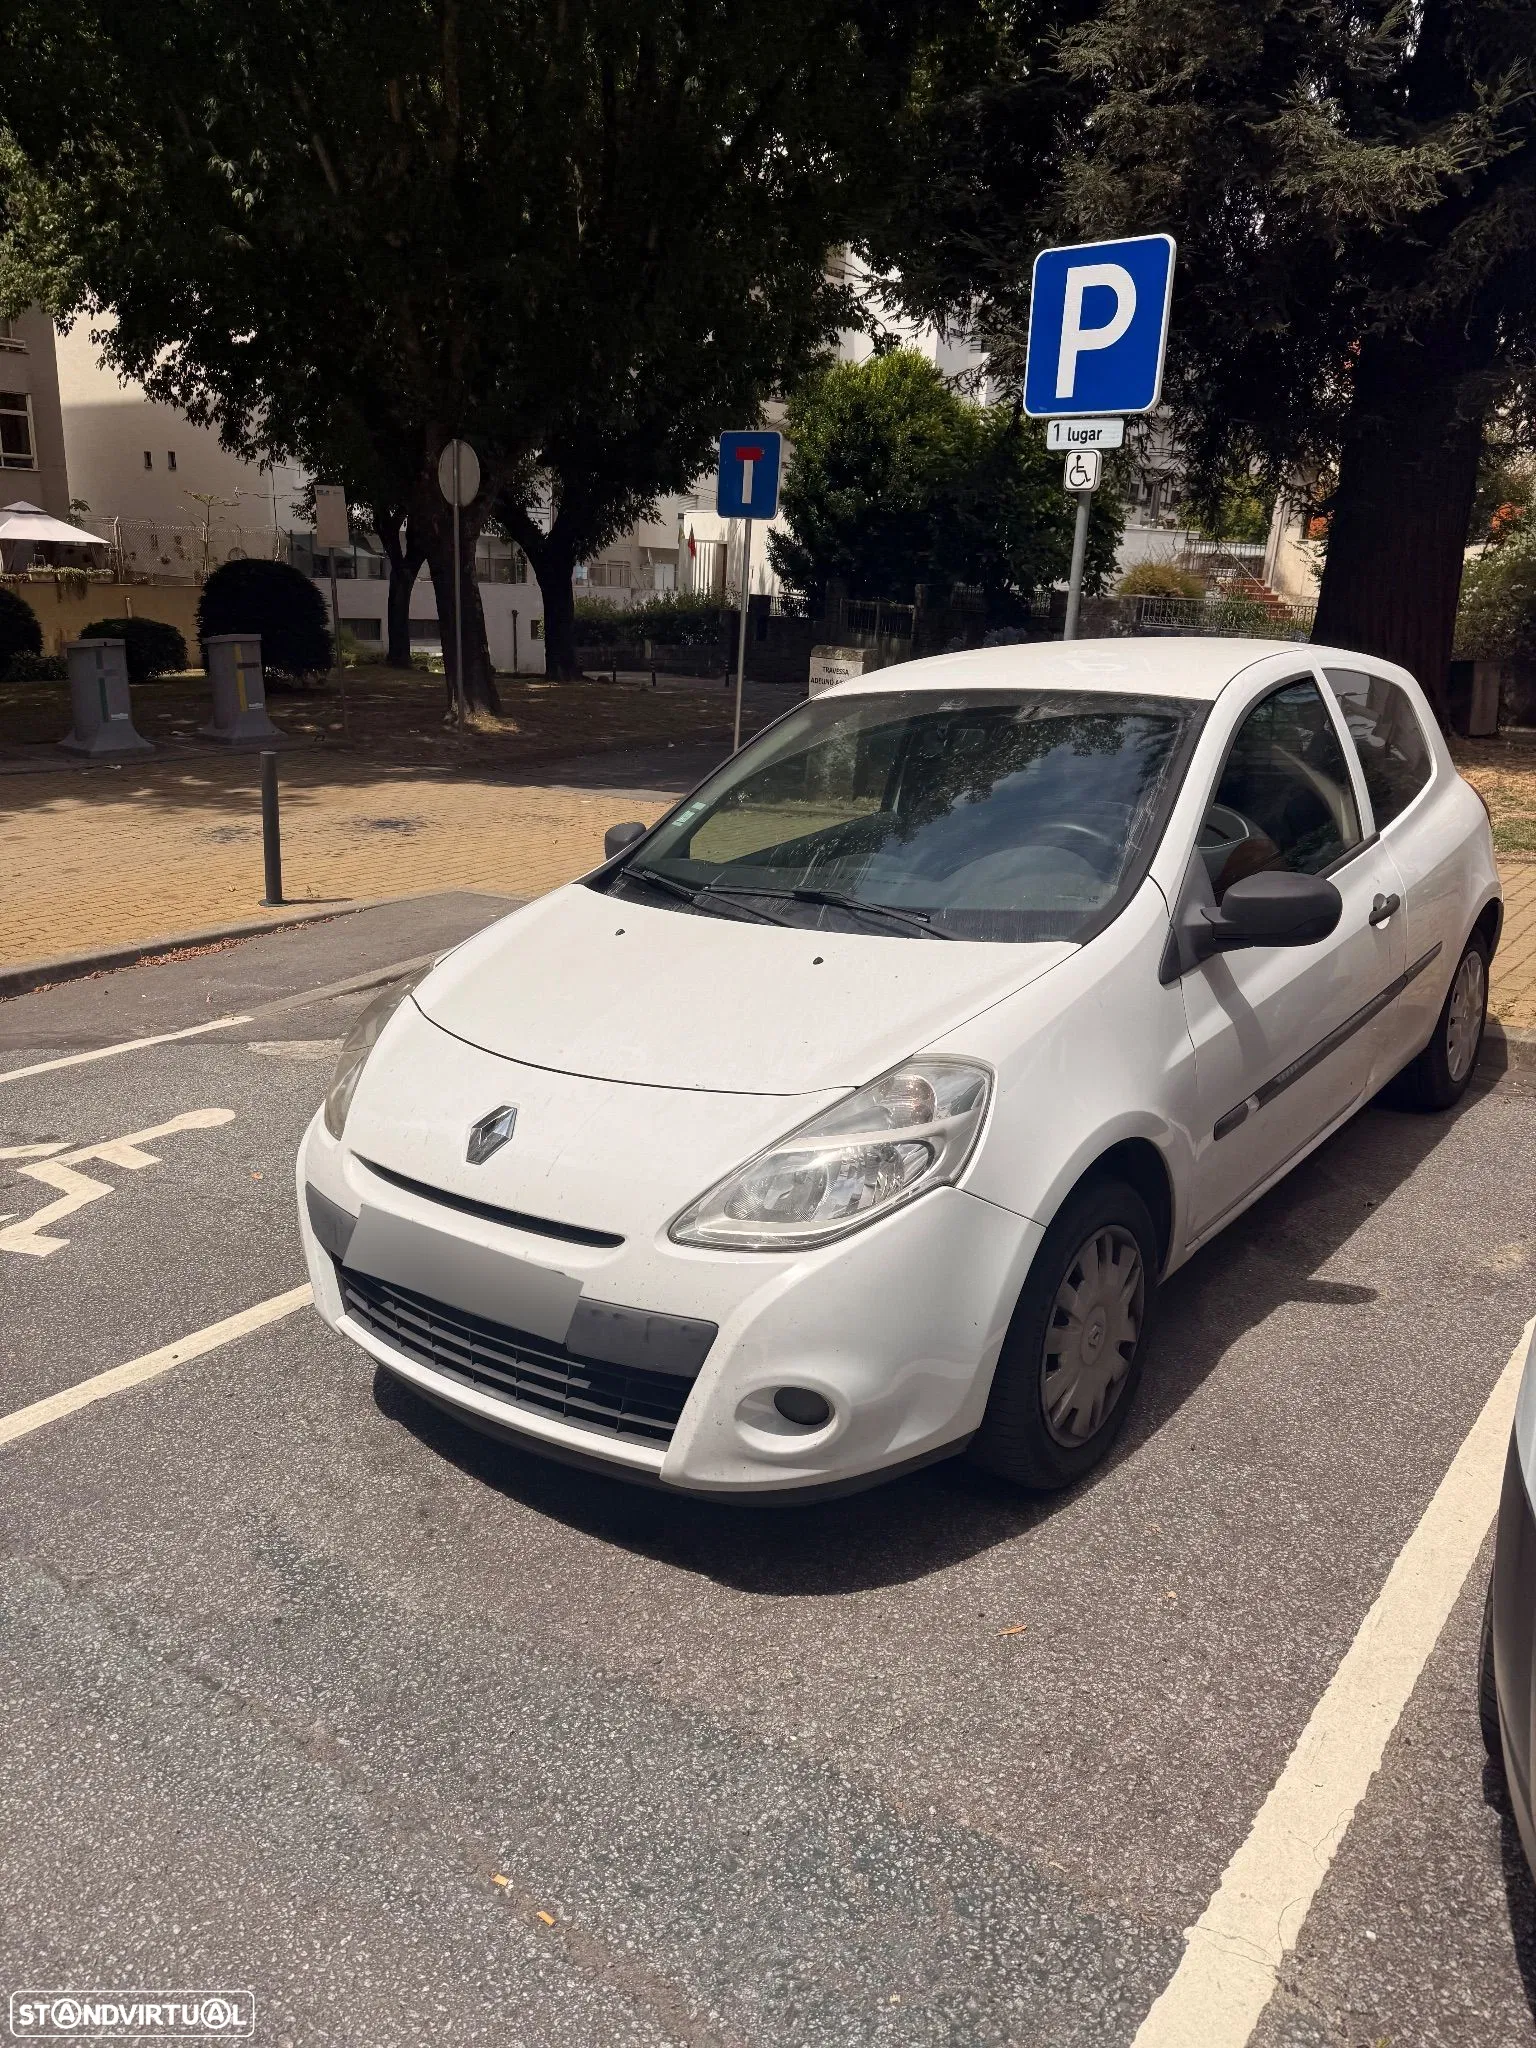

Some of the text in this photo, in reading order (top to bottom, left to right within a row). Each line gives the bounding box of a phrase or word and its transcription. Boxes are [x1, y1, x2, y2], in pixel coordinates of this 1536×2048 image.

[1055, 263, 1137, 399] P
[1053, 423, 1103, 444] 1 lugar
[822, 667, 849, 676] TRAVESSA
